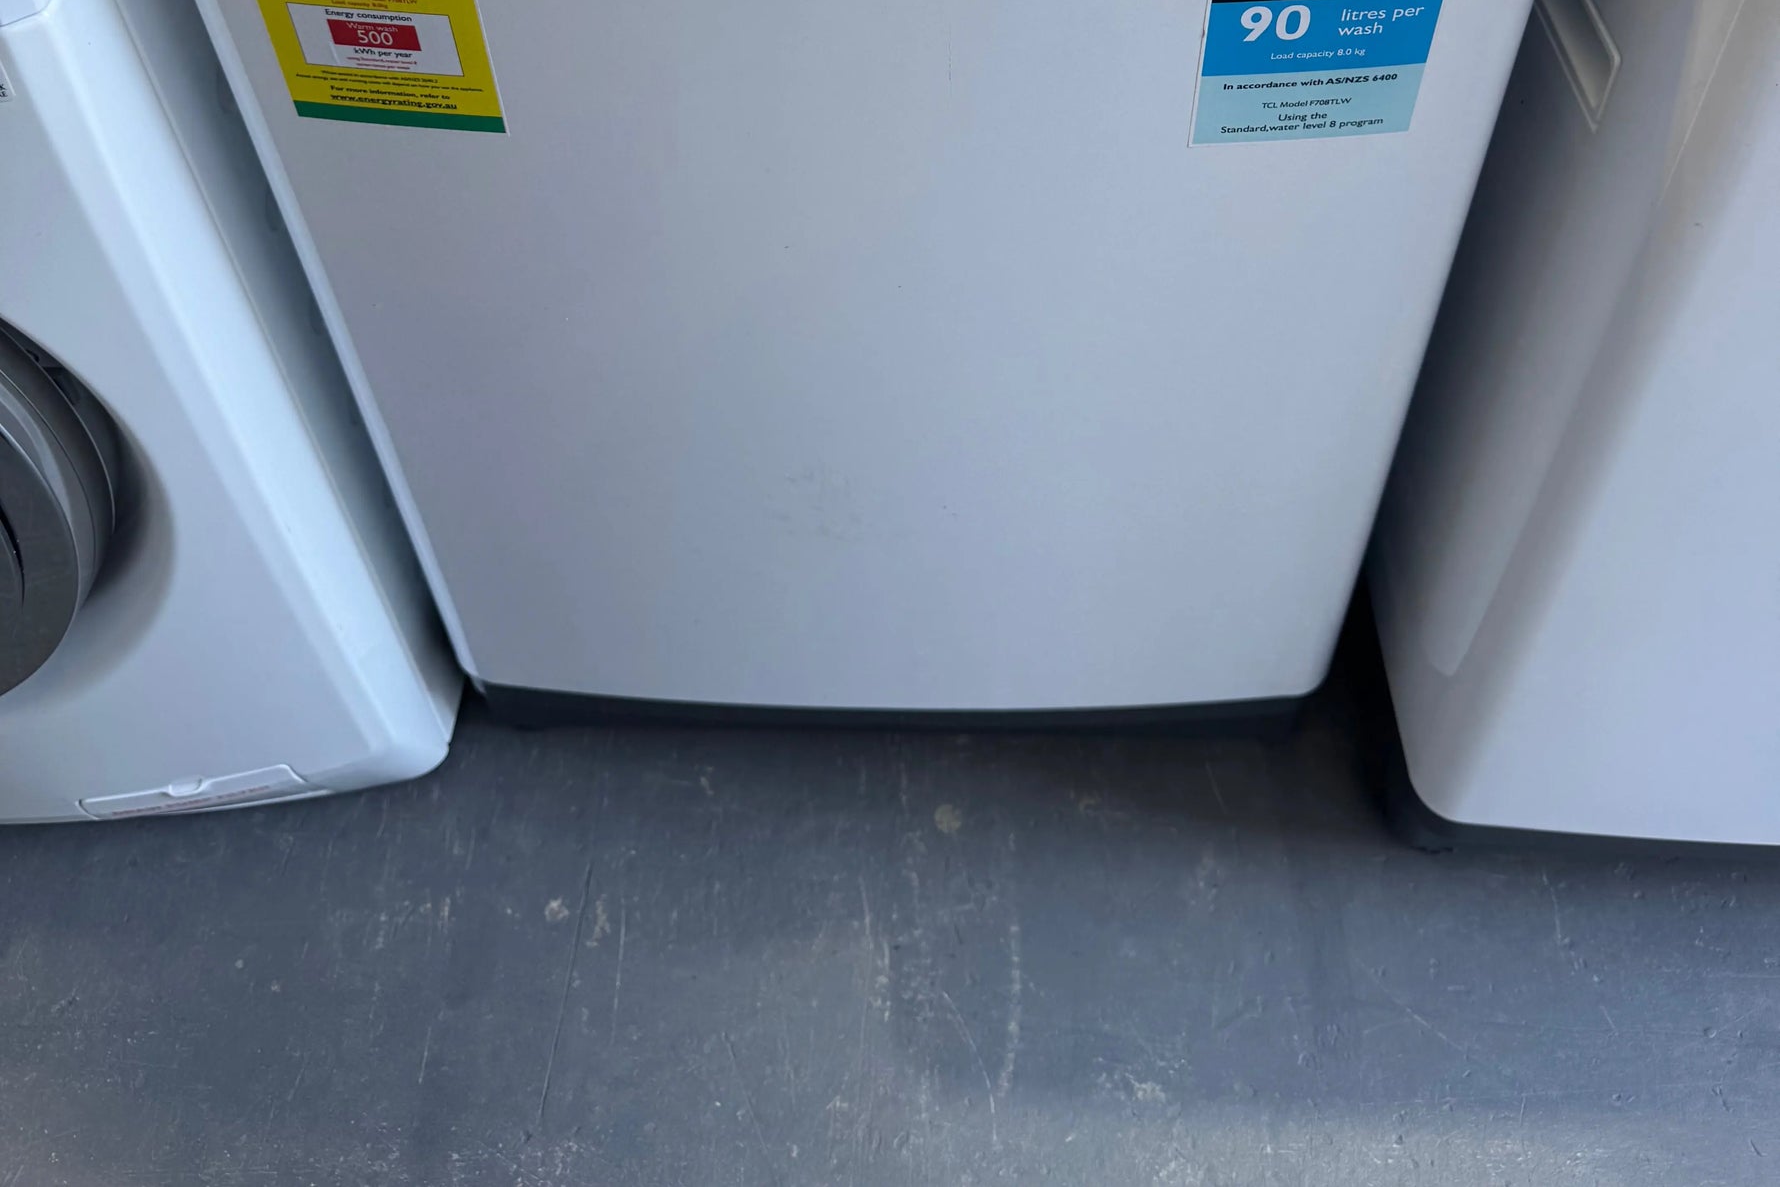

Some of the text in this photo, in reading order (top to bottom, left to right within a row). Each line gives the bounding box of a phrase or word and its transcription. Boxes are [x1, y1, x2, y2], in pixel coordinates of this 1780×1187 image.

[325, 8, 412, 23] Energy consumption
[1341, 6, 1425, 22] litres per
[346, 22, 375, 31] Warm
[1240, 4, 1311, 42] 90
[1338, 22, 1384, 36] wash
[357, 30, 394, 46] 500
[354, 47, 413, 60] kWh per year
[1270, 47, 1366, 60] Load capacity 8.0 kg
[1223, 73, 1398, 91] In accordance with AS/NZS 6400
[330, 85, 344, 93] For
[419, 91, 441, 100] refer
[330, 94, 458, 111] www.energyrating.gov.au
[1261, 97, 1353, 109] TCL Model F708TLW
[1278, 111, 1328, 122] Using the
[1220, 117, 1384, 134] Standard,water level 8 program
